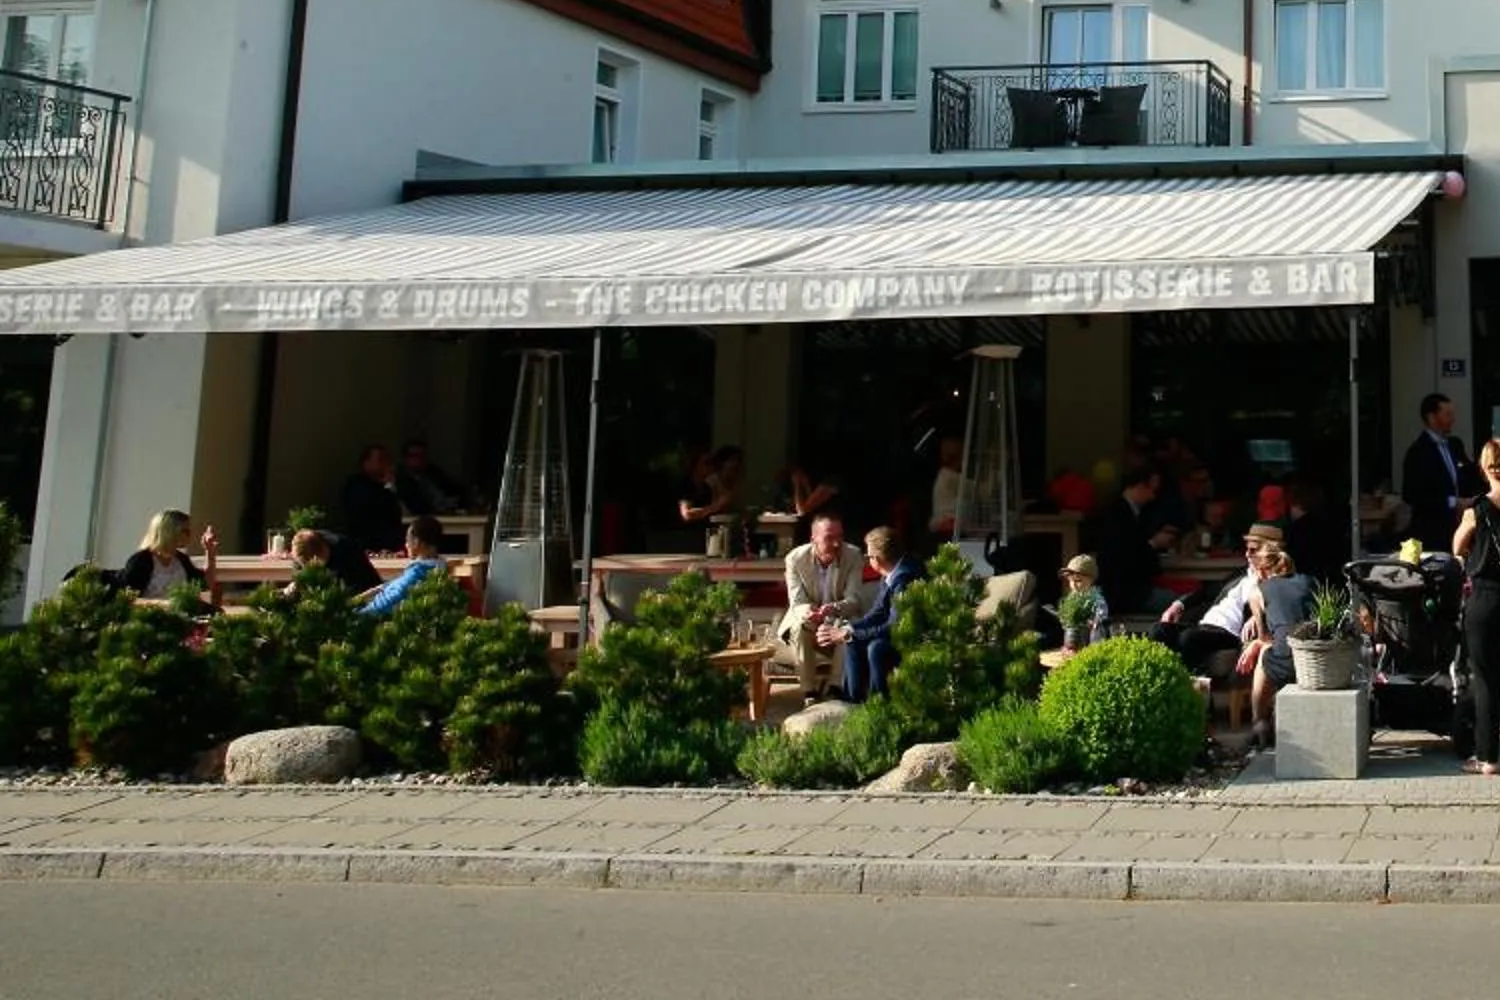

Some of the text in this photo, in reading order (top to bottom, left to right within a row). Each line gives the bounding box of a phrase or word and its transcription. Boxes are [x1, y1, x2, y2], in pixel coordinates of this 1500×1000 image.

[95, 292, 118, 323] &
[130, 292, 196, 322] BAR
[257, 288, 366, 321] WINGS
[377, 289, 400, 319] &
[413, 287, 530, 319] DRUMS
[572, 285, 632, 316] THE
[645, 280, 787, 315] CHICKEN
[801, 275, 971, 310] COMPANY
[1028, 267, 1233, 304] ROTISSERIE
[1247, 266, 1273, 296] &
[1286, 262, 1359, 296] BAR
